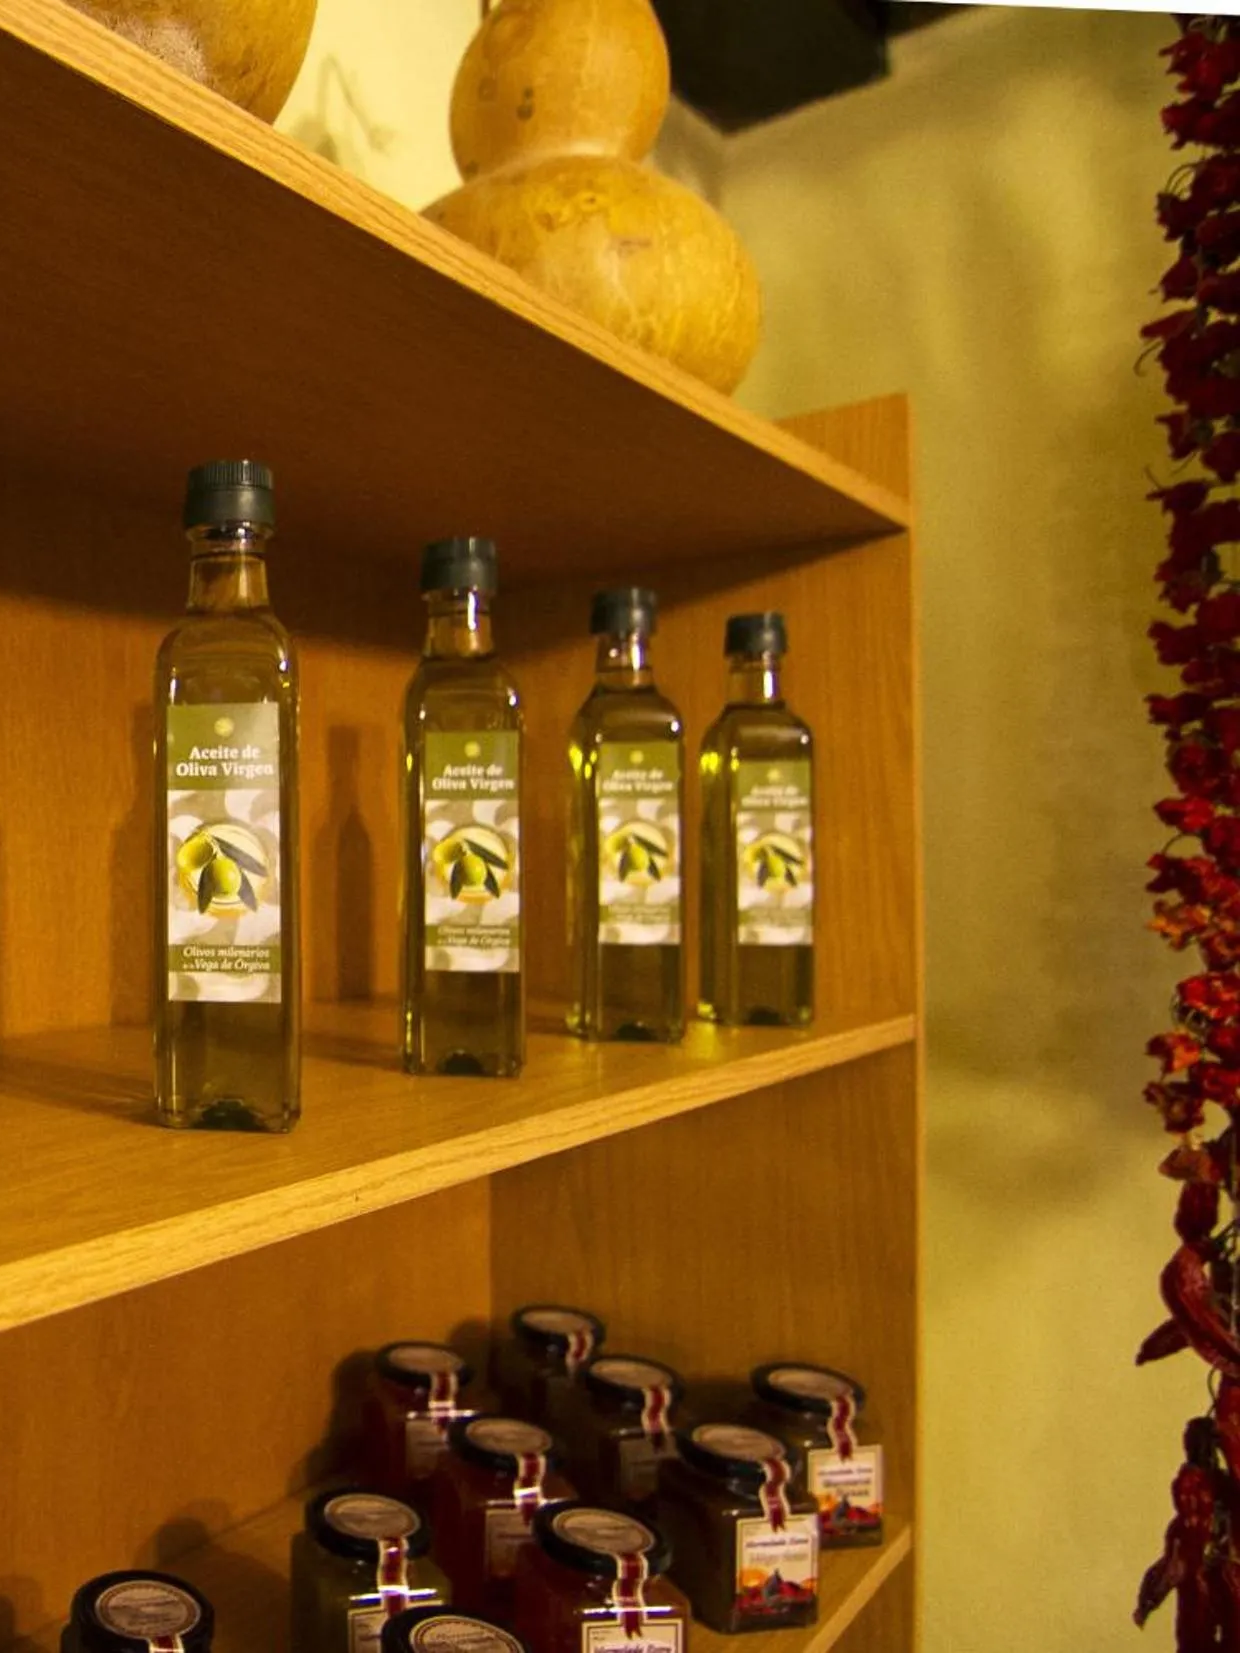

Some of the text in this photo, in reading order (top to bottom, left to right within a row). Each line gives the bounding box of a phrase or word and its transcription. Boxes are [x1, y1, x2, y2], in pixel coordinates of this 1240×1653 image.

[189, 744, 261, 760] Aceite de
[176, 762, 274, 779] Oliva Virgen
